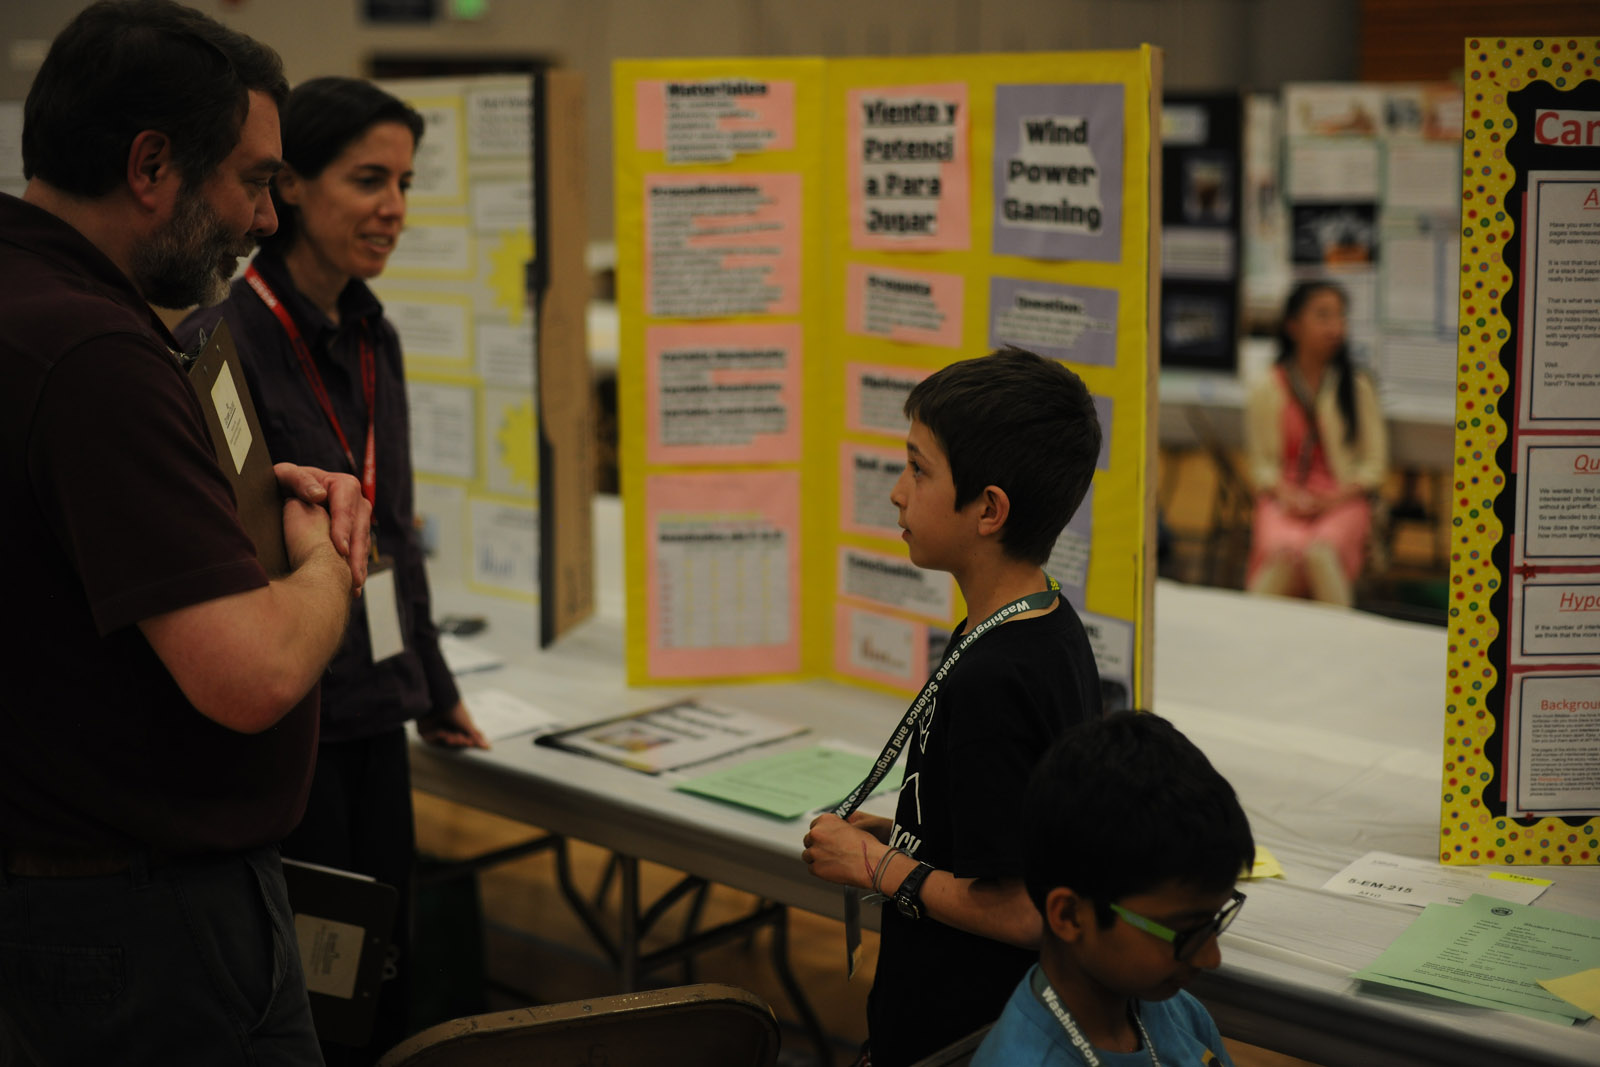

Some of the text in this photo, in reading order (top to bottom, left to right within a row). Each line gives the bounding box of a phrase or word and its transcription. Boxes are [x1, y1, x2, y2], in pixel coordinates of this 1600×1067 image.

[1026, 119, 1088, 144] Wind
[886, 174, 941, 196] Para
[1009, 160, 1096, 185] Power
[1003, 199, 1103, 231] Gaming
[1574, 453, 1600, 473] Qu
[960, 600, 1031, 650] Washington
[935, 650, 961, 681] State
[906, 681, 939, 726] Science
[892, 726, 909, 749] and
[1347, 878, 1413, 893] 5-EM-215
[1041, 985, 1101, 1067] Washington
